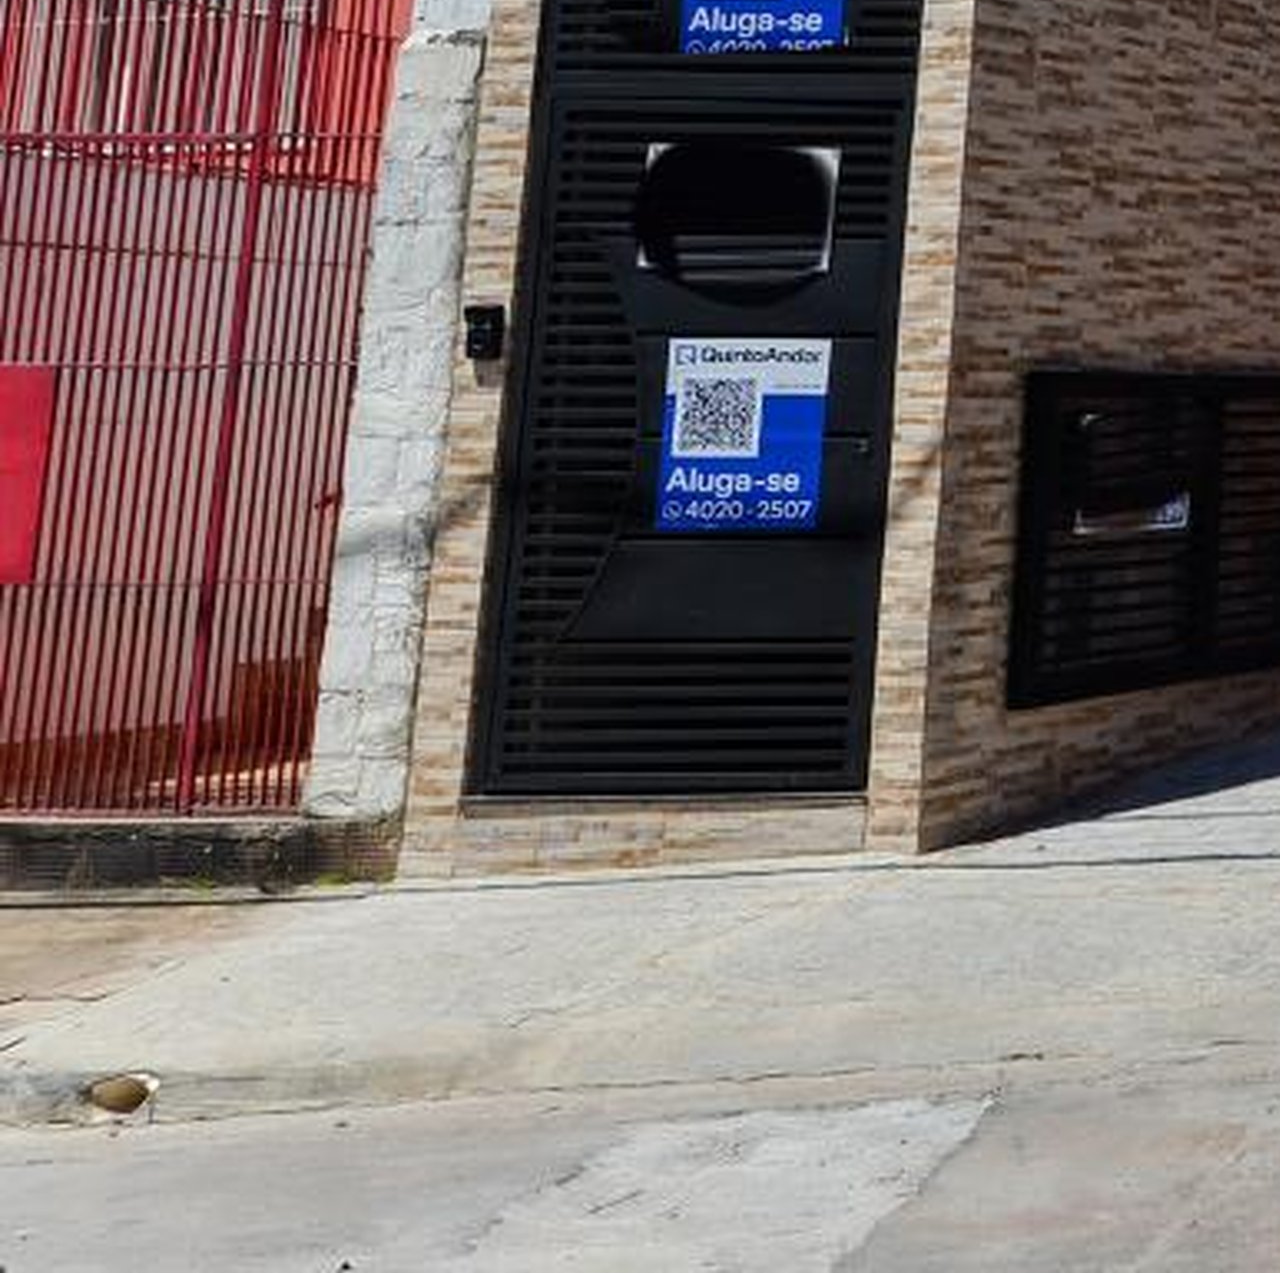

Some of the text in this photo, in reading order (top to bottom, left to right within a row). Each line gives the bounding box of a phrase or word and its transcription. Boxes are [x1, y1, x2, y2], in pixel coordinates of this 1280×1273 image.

[688, 5, 823, 38] Aluga-se
[701, 346, 823, 364] QuintoAndar
[665, 466, 801, 499] Aluga-se
[685, 500, 743, 519] 4020
[757, 499, 813, 519] 2507
